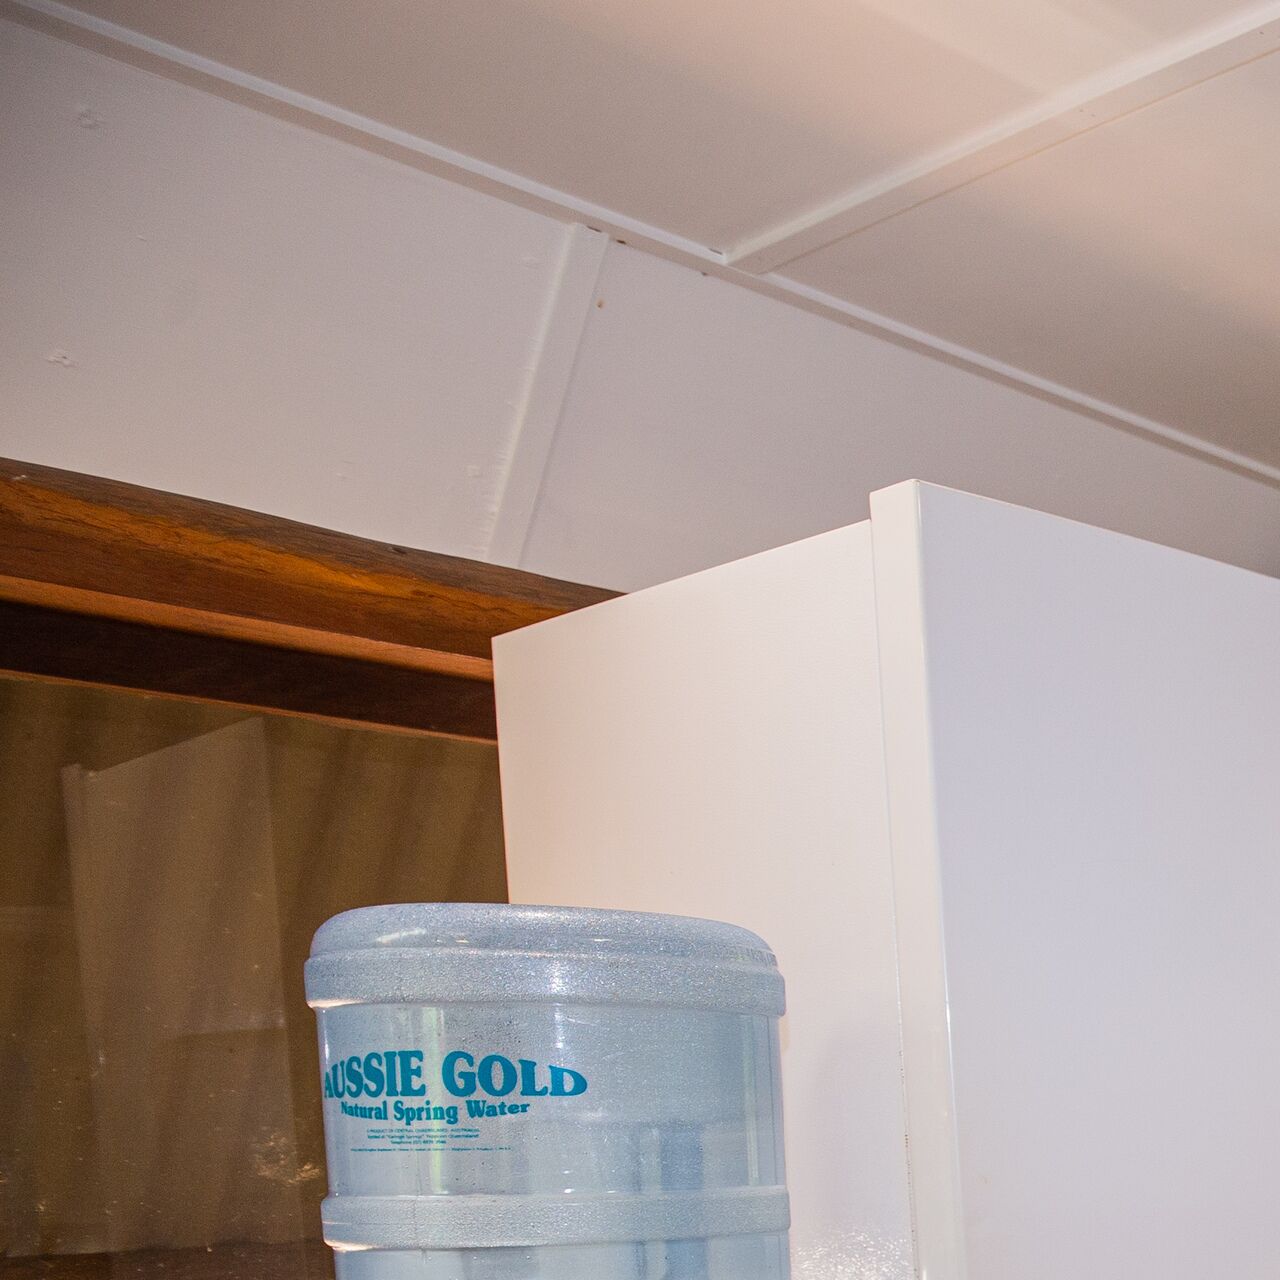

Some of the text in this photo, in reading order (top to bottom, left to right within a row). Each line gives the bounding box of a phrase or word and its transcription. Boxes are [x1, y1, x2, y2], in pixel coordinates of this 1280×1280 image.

[324, 1050, 588, 1098] AUSSIE GOLD
[341, 1099, 531, 1125] Natural Spring Water
